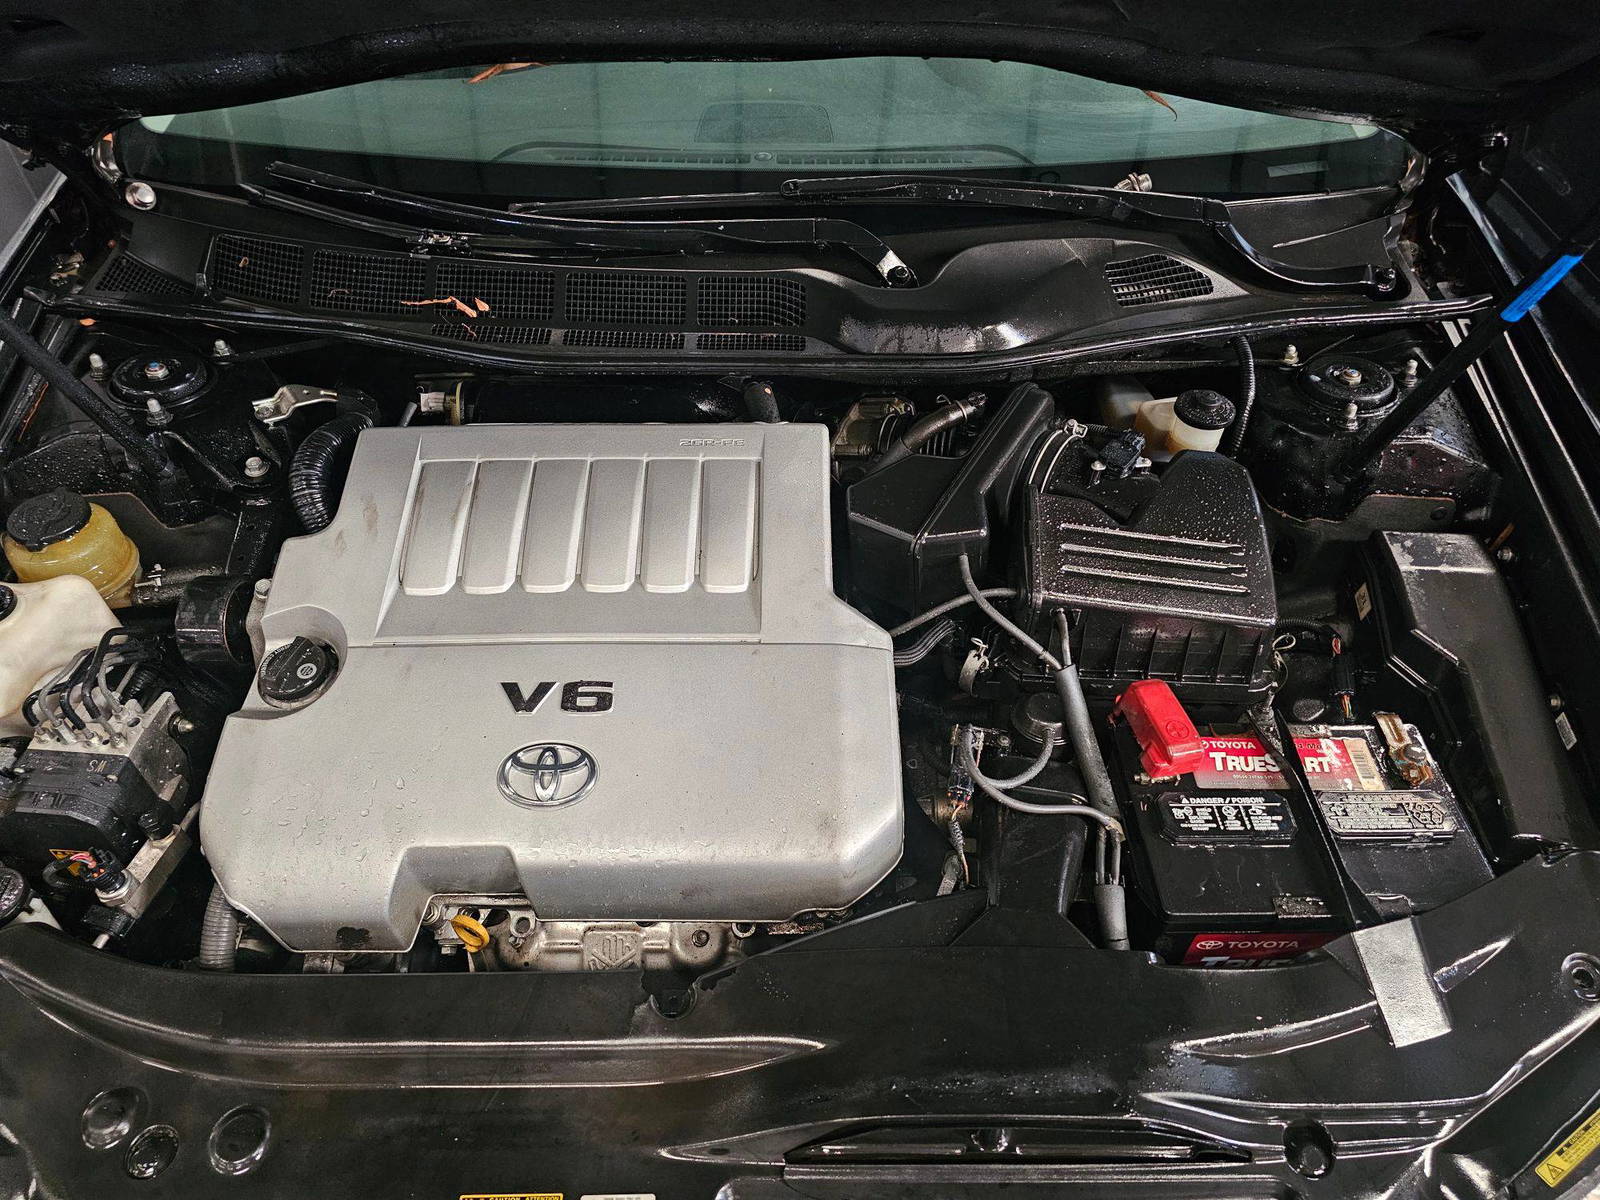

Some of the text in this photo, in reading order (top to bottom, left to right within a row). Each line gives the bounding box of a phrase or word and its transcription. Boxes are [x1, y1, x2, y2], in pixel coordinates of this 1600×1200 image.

[500, 681, 614, 715] V6
[1210, 741, 1256, 750] TOYOTA
[1228, 940, 1299, 949] TOYOTA
